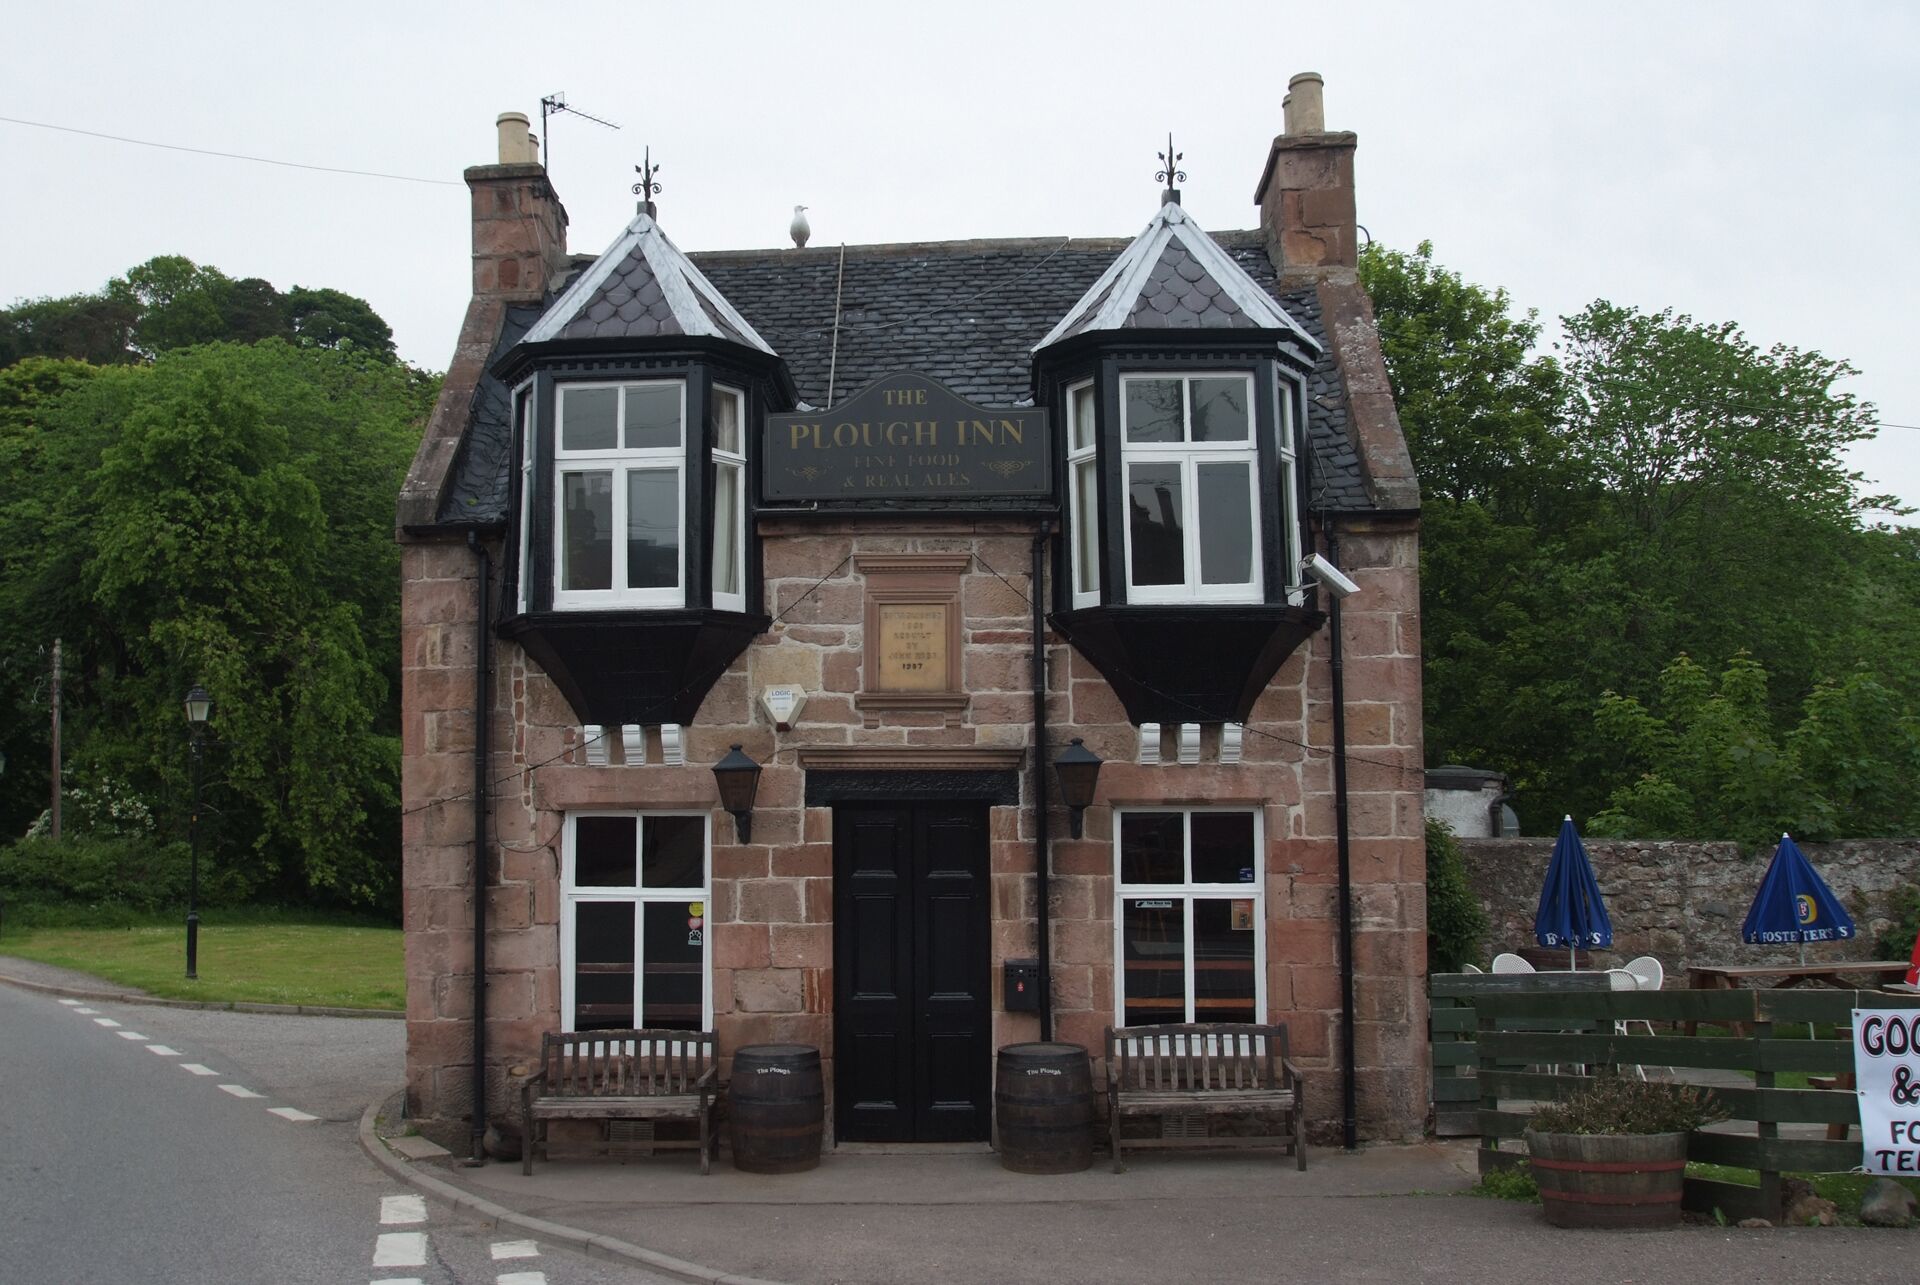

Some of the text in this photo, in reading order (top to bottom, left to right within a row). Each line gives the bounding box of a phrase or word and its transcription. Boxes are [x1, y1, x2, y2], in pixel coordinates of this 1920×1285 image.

[882, 389, 928, 405] THE
[788, 419, 1025, 449] PLOUGH INN
[854, 453, 960, 468] FINE FOOD
[865, 473, 915, 488] REAL
[922, 473, 970, 487] ALES
[1890, 1063, 1920, 1107] &
[1875, 1149, 1920, 1172] TE
